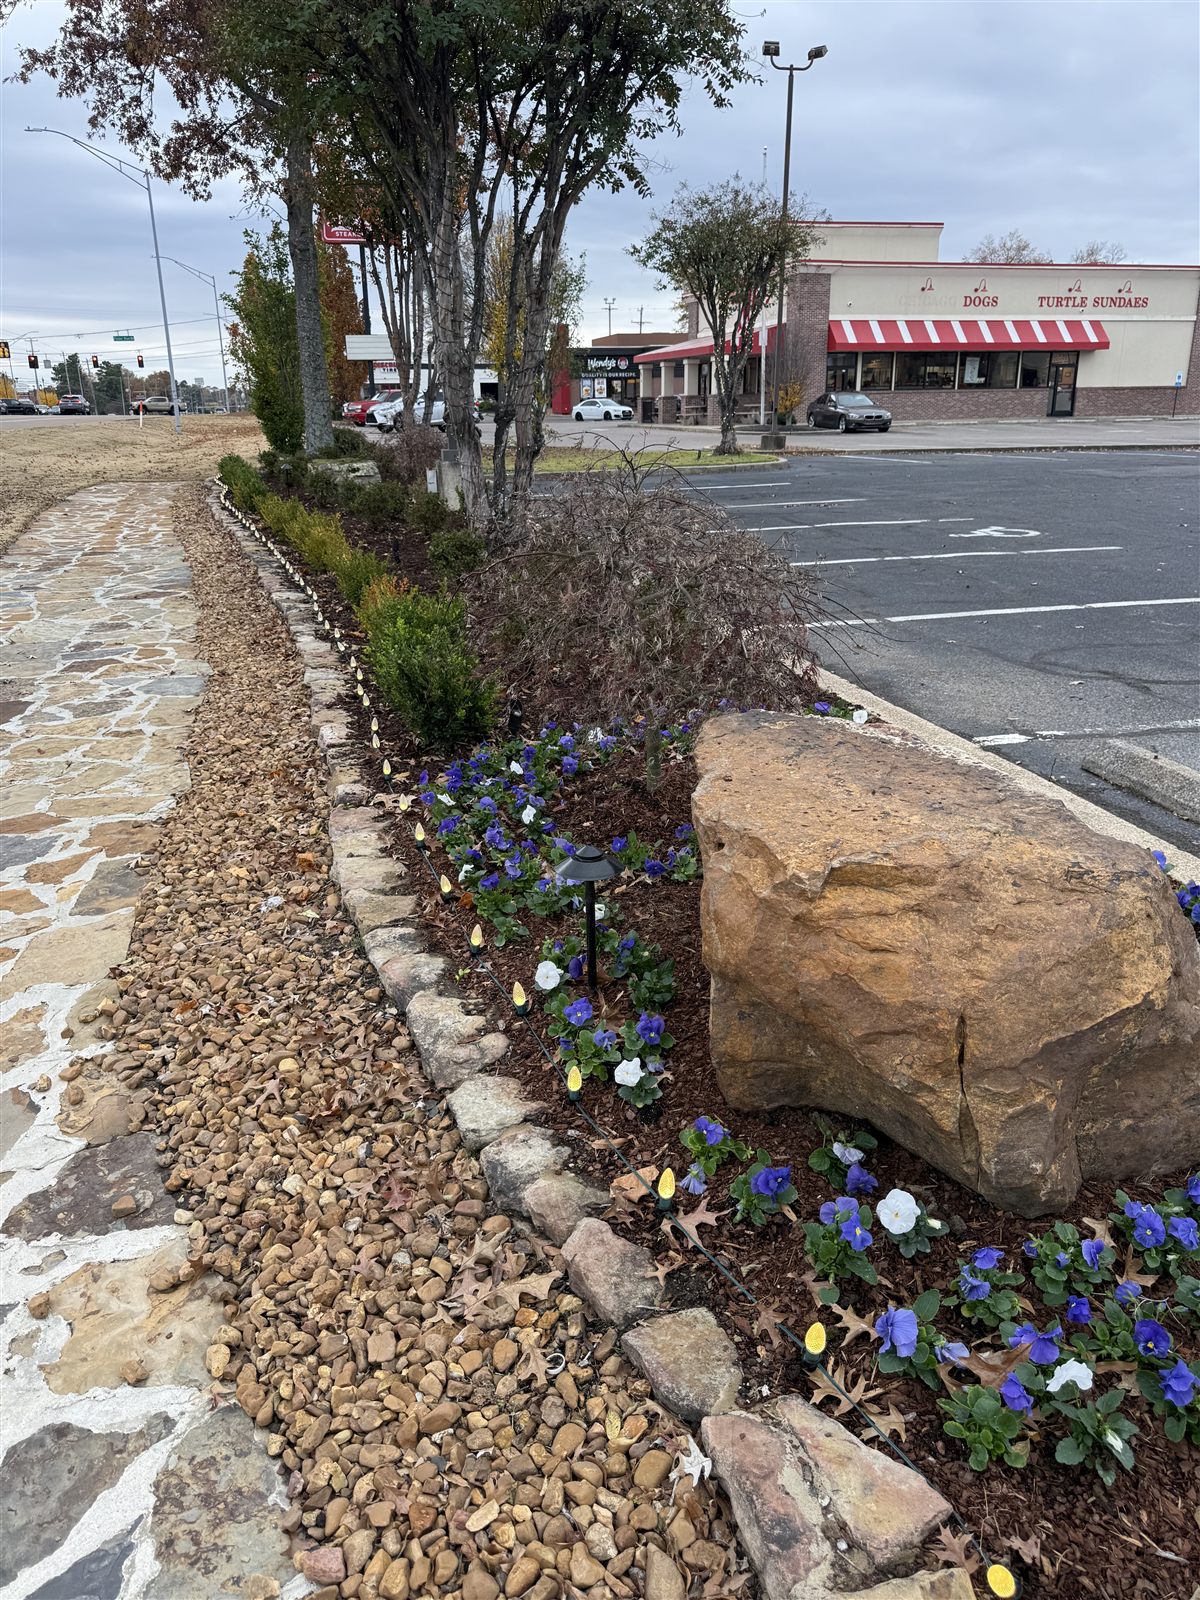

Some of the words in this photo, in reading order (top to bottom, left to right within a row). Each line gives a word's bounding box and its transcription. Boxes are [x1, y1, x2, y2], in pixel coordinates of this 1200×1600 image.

[963, 295, 999, 307] DOGS
[1038, 296, 1088, 308] TURTLE
[1092, 296, 1149, 308] SUNDAES
[587, 356, 617, 371] Wendy's
